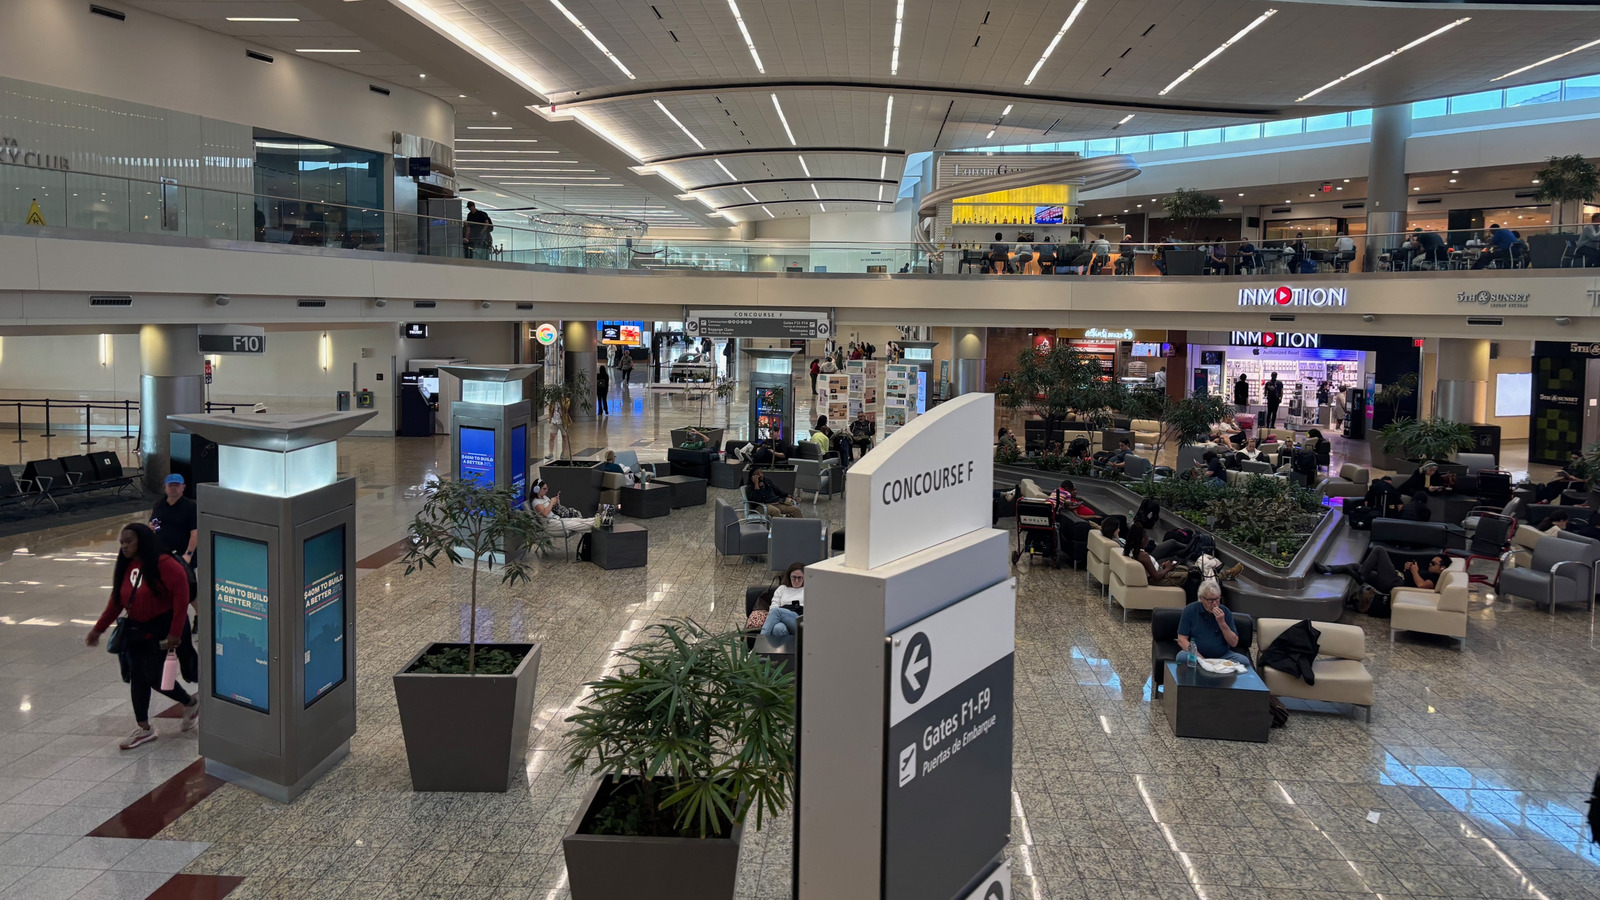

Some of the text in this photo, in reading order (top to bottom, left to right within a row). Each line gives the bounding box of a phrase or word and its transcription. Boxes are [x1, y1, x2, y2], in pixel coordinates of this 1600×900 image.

[1238, 287, 1347, 306] INMOTION
[1457, 291, 1530, 303] 5TH & SUNSET
[232, 336, 260, 351] F10
[1231, 331, 1318, 348] INMOTION
[1570, 343, 1589, 352] 5TH
[882, 461, 973, 505] CONCOURSE F
[215, 583, 236, 595] $40M
[236, 588, 246, 597] TO
[247, 591, 269, 602] BUILD
[304, 585, 320, 600] $40M
[320, 582, 328, 591] TO
[328, 574, 343, 587] BUILD
[224, 595, 252, 608] BETTER
[306, 600, 310, 608] A
[310, 588, 332, 605] BETTER
[923, 687, 991, 752] Gates F1-F9
[922, 715, 997, 777] Puertas de Embarque
